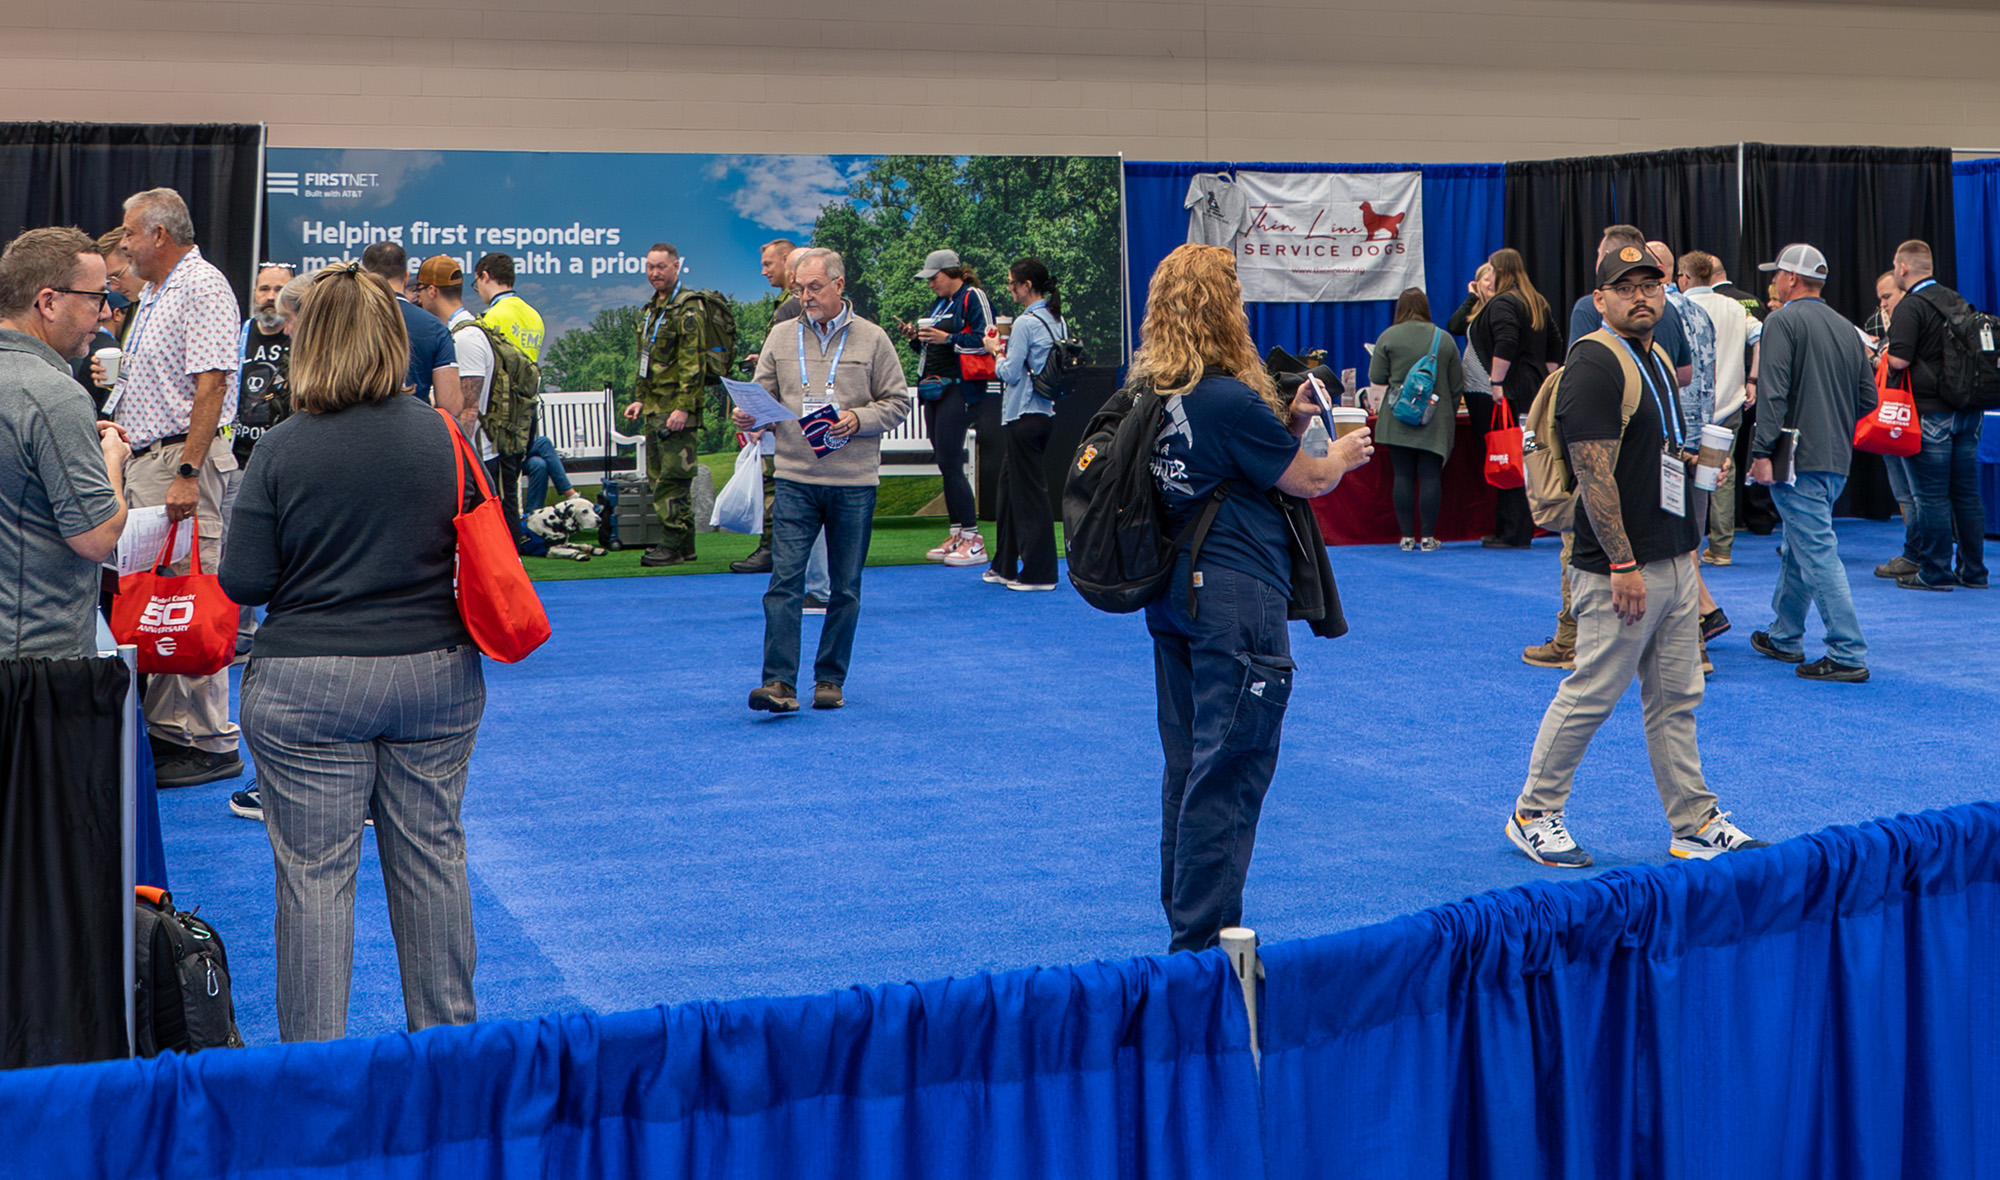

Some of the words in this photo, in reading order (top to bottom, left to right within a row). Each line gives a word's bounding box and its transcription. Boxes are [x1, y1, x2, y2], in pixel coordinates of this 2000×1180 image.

[304, 190, 323, 198] Built
[324, 190, 341, 198] with
[342, 190, 363, 198] AT&T
[1244, 203, 1297, 238] Thin
[1304, 209, 1364, 241] Line
[302, 220, 404, 249] Helping
[410, 221, 469, 245] first
[475, 222, 621, 250] responders
[1244, 243, 1341, 257] SERVICE
[1352, 242, 1406, 257] DOGS
[568, 256, 584, 275] a
[1878, 405, 1911, 422] 50
[139, 601, 195, 627] 50
